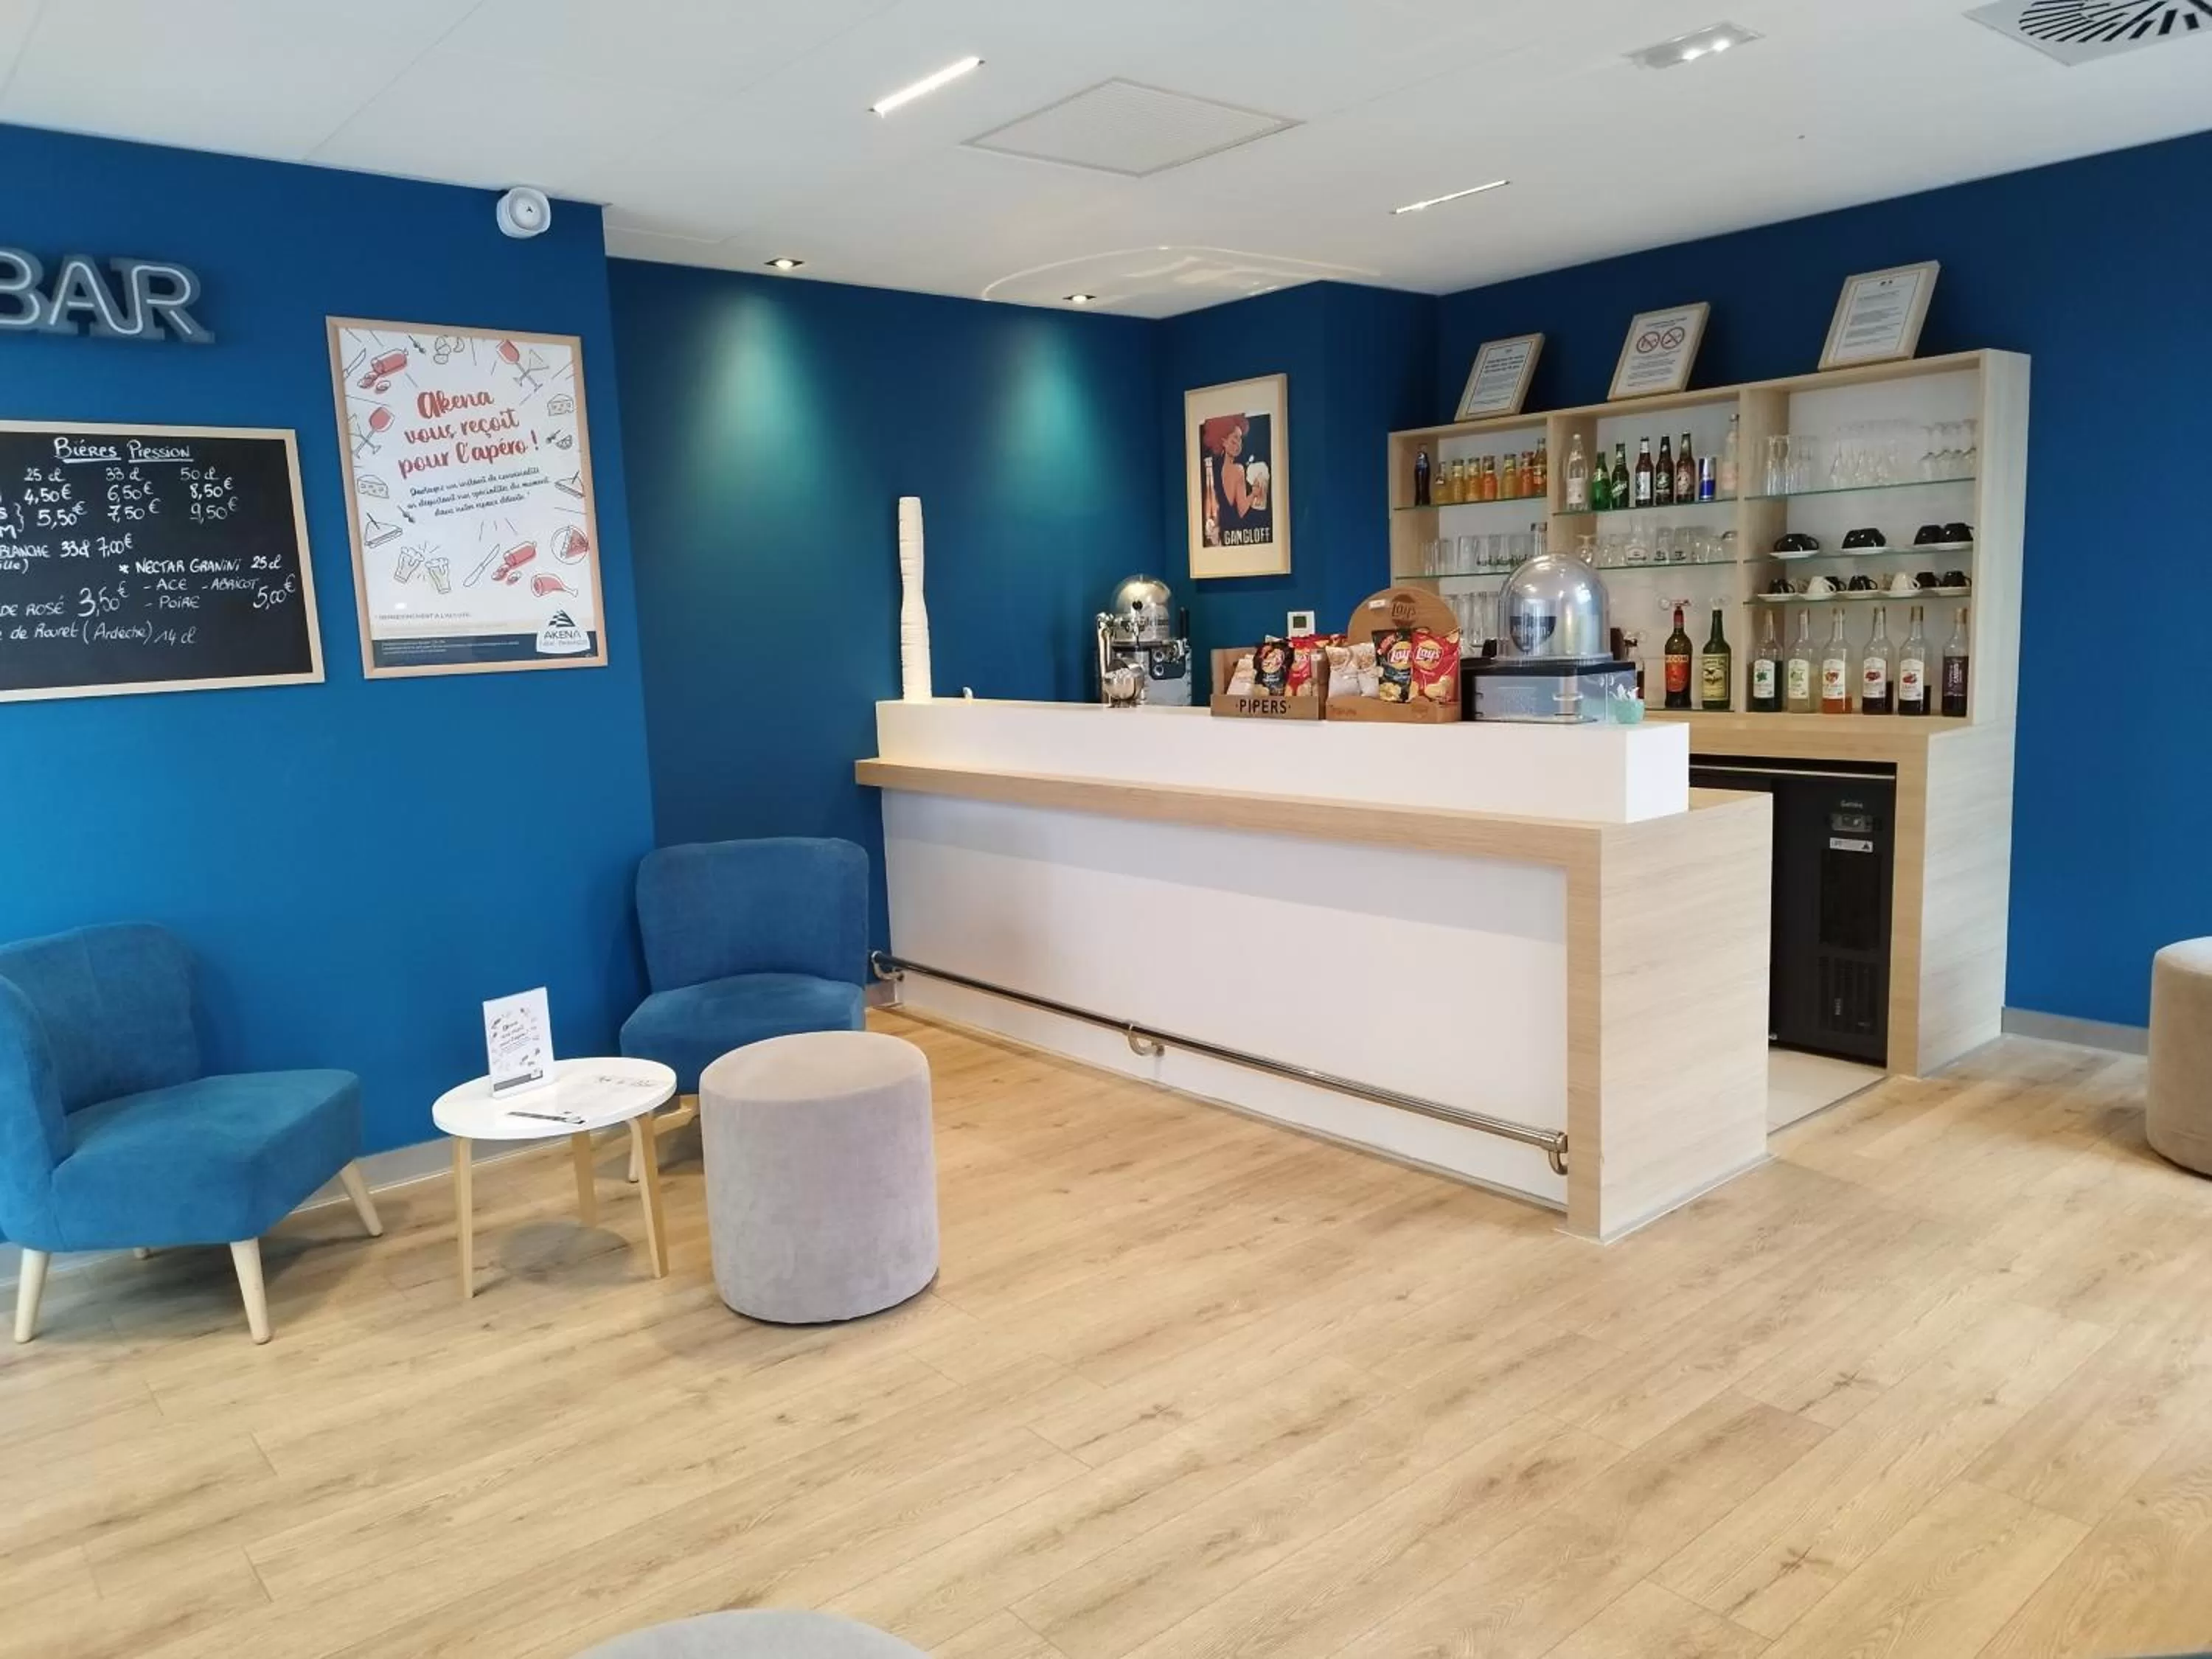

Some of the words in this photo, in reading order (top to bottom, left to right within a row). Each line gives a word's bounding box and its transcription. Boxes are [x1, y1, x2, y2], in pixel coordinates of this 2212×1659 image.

[0, 247, 215, 343] BAR
[417, 390, 495, 419] Akena
[404, 423, 456, 444] vous
[461, 408, 520, 438] reçoit
[398, 451, 449, 479] pour
[456, 438, 528, 464] l'apéro
[24, 467, 42, 481] 25
[105, 467, 125, 481] 33
[180, 467, 201, 481] 50
[1223, 527, 1270, 545] GANGLOFF
[135, 557, 185, 574] NECTAR
[156, 577, 188, 591] ACE
[10, 625, 29, 640] de
[544, 630, 581, 639] AKENA
[1391, 649, 1412, 663] Lay
[1415, 647, 1441, 661] Lay's
[1239, 699, 1287, 714] PIPERS
